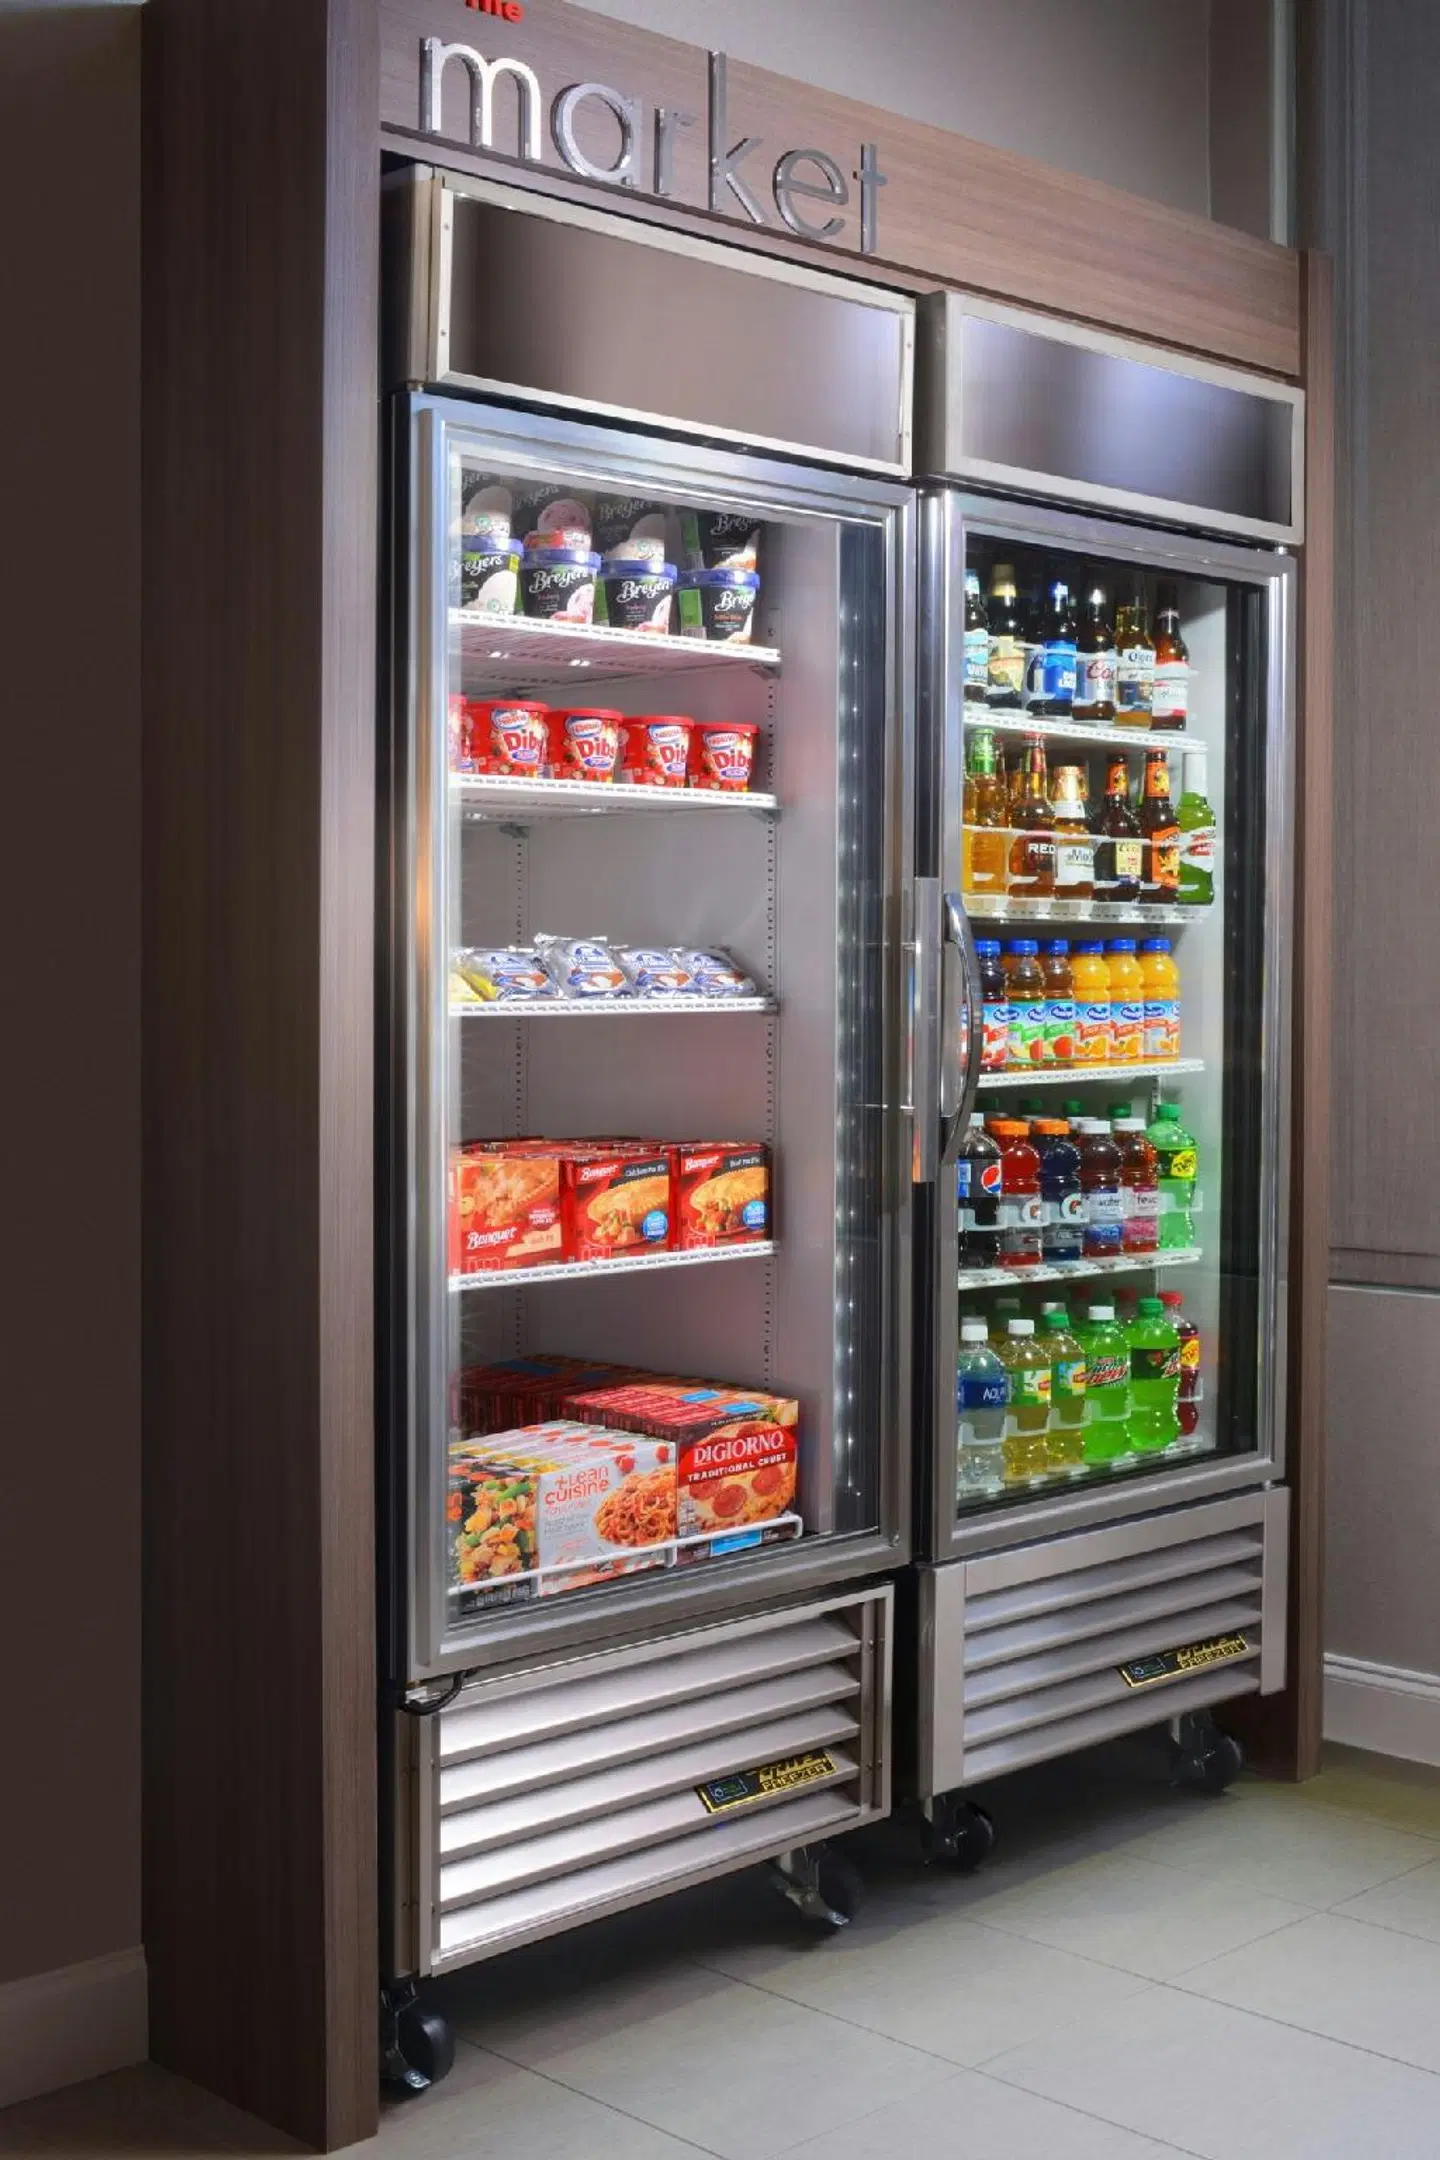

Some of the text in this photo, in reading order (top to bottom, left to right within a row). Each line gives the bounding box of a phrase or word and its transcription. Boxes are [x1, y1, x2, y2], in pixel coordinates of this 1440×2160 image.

[418, 36, 888, 254] market
[580, 1164, 619, 1182] Banquet
[685, 1156, 720, 1172] Banquet
[467, 1227, 518, 1250] Banquet
[693, 1430, 785, 1467] DIGIORNO
[687, 1453, 788, 1482] TRADITIONAL CRUST
[761, 1763, 828, 1792] FREEZER
